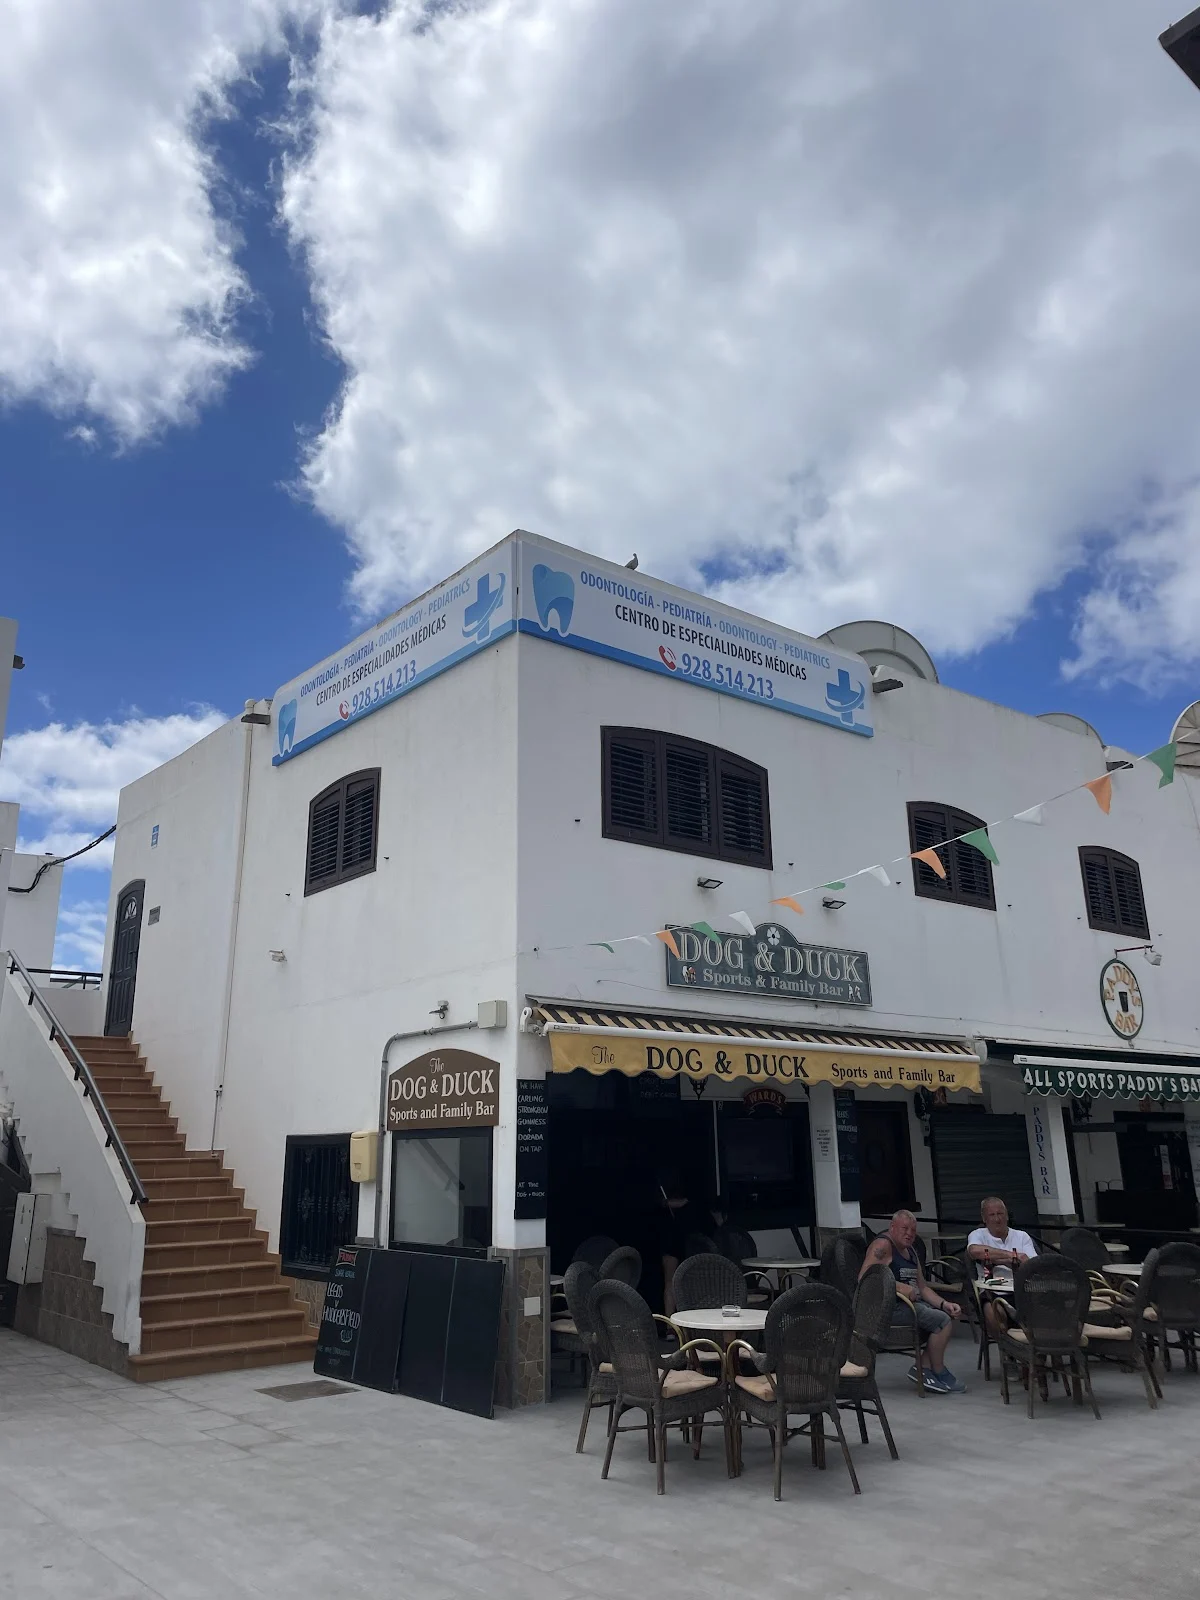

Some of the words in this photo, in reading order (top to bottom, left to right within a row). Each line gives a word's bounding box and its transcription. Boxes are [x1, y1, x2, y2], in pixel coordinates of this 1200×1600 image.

[580, 570, 654, 608] ODONTOLOGÍA
[663, 600, 712, 628] PEDIATRÍA
[719, 620, 776, 650] ODONTOLOGY
[784, 642, 830, 669] PEDIATRICS
[300, 662, 340, 698] ODONTOLOGÍA
[344, 640, 374, 671] PEDIATRÍA
[378, 609, 422, 647] ODONTOLOGY
[428, 578, 470, 616] PEDIATRICS
[615, 604, 659, 632] CENTRO
[662, 620, 676, 638] DE
[679, 626, 763, 666] ESPECIALIDADES
[765, 655, 807, 680] MÉDICAS
[316, 681, 341, 706] CENTRO
[342, 675, 350, 691] DE
[352, 637, 409, 685] ESPECIALIDADES
[410, 614, 446, 648] MÉDICAS
[681, 652, 774, 699] 928.514.213
[352, 660, 416, 715] 928.514.213
[676, 930, 744, 969] DOG
[754, 942, 776, 972] &
[781, 945, 863, 983] DUCK
[703, 968, 752, 986] Sports
[756, 974, 766, 988] &
[770, 976, 816, 996] Family
[818, 981, 844, 996] Bar
[1115, 1010, 1138, 1033] BAR
[430, 1057, 444, 1074] The
[592, 1046, 615, 1065] The
[646, 1046, 703, 1072] DOG
[715, 1050, 732, 1074] &
[745, 1052, 809, 1078] DUCK
[831, 1063, 868, 1080] Sports
[874, 1066, 893, 1080] and
[899, 1067, 932, 1084] Family
[938, 1070, 956, 1083] Bar
[1024, 1068, 1052, 1087] ALL
[1058, 1070, 1114, 1090] SPORTS
[390, 1076, 427, 1101] DOG
[430, 1079, 438, 1093] &
[441, 1069, 494, 1097] DUCK
[518, 1094, 544, 1103] CARLING
[520, 1082, 528, 1090] WE
[390, 1106, 418, 1124] Sports
[420, 1104, 437, 1119] and
[440, 1101, 473, 1120] Family
[476, 1100, 495, 1116] Bar
[1040, 1167, 1051, 1194] BAR
